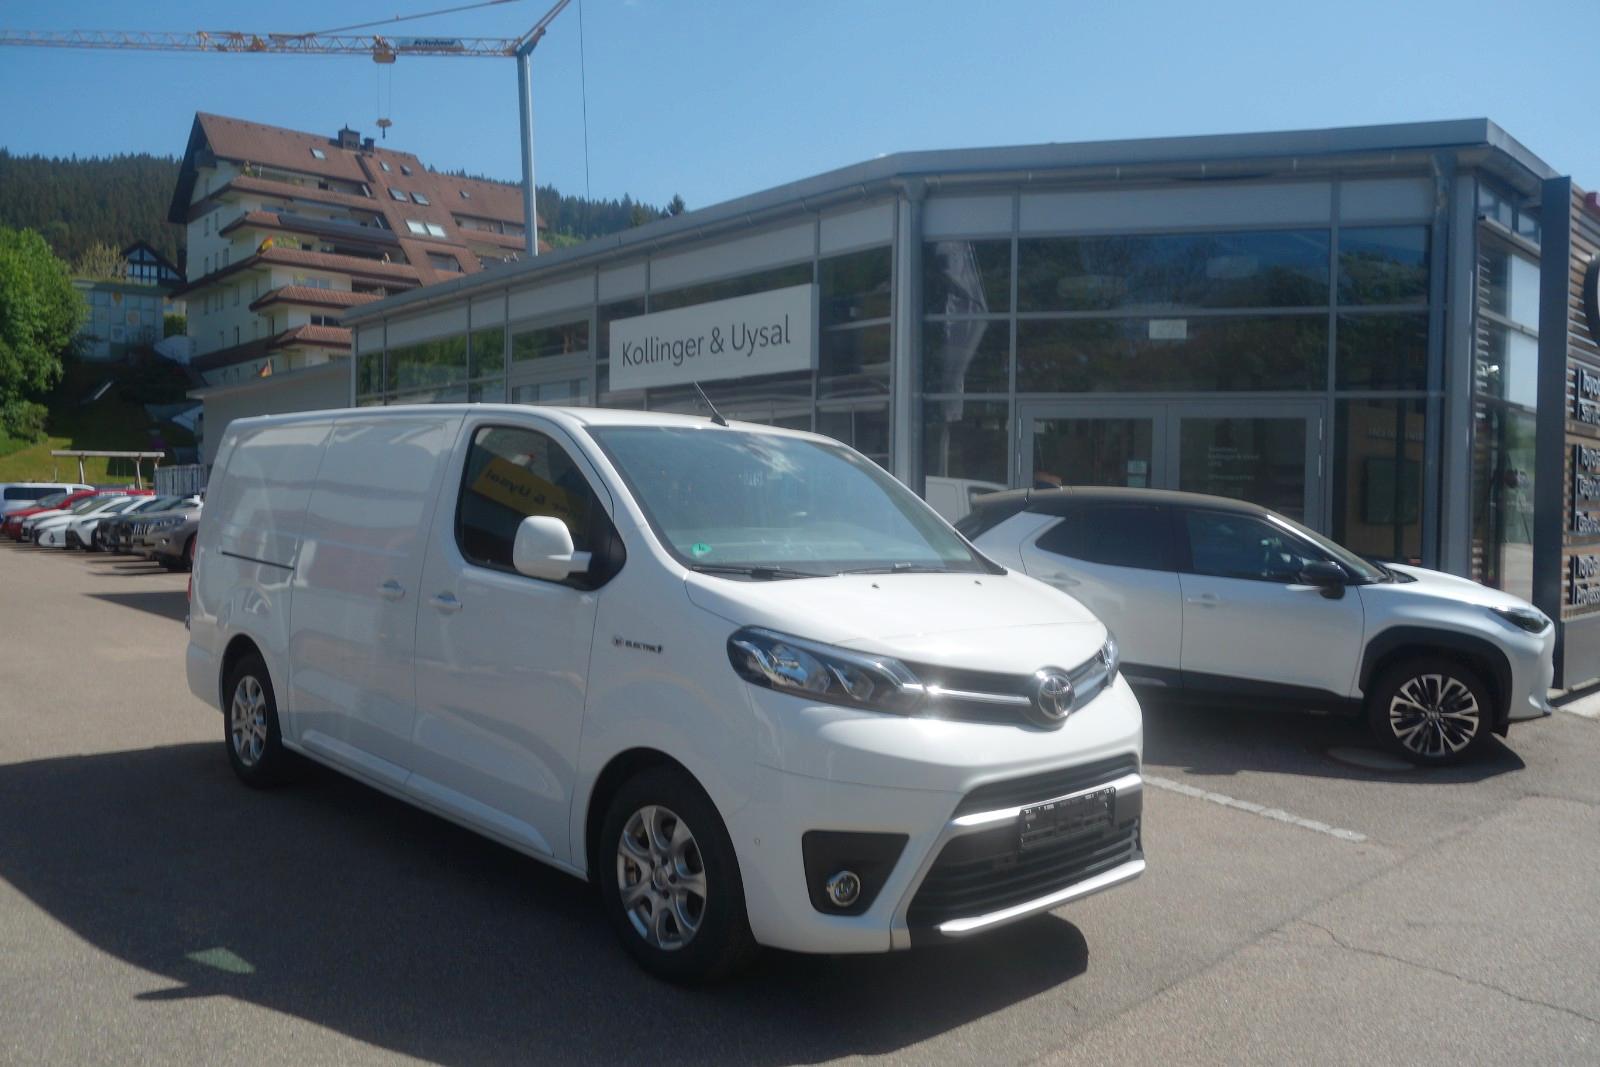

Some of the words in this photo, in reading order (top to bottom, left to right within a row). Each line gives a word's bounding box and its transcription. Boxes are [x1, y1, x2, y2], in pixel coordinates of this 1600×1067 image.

[622, 335, 704, 368] Kollinger
[710, 326, 724, 355] &
[731, 313, 791, 357] Uysal
